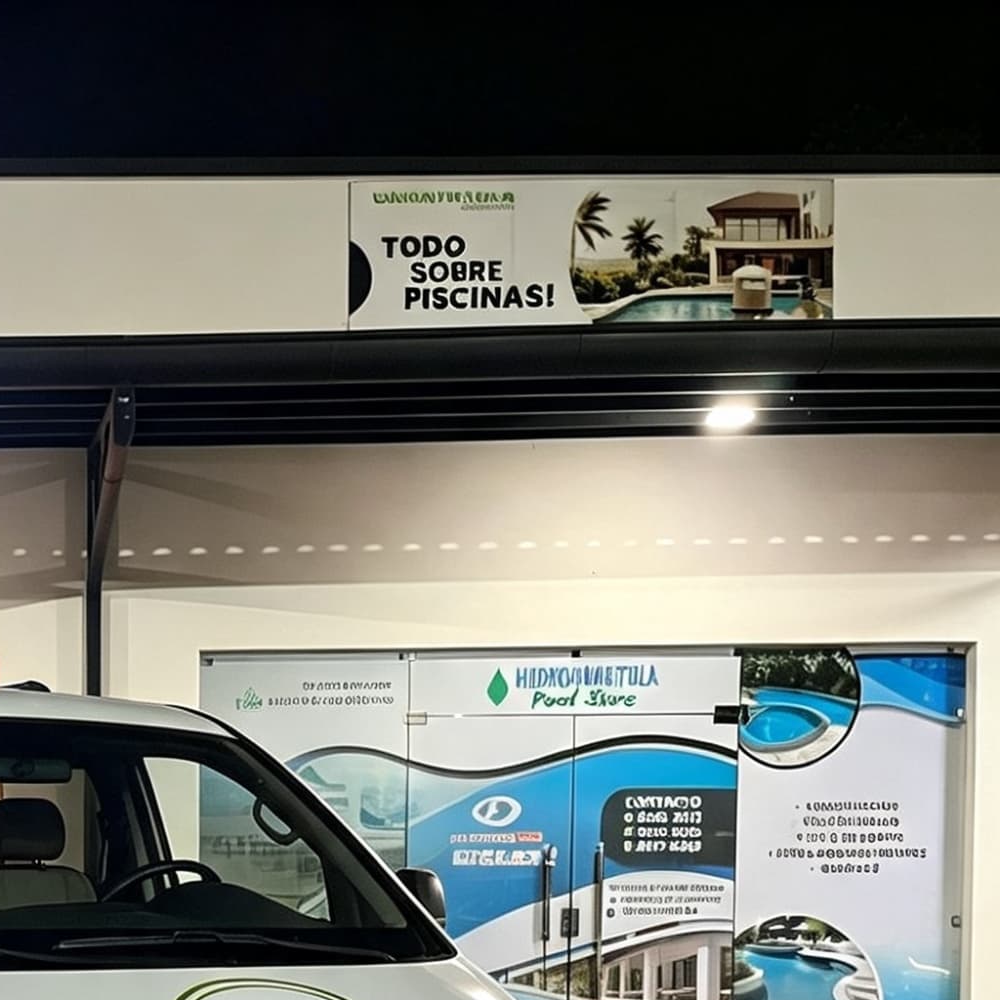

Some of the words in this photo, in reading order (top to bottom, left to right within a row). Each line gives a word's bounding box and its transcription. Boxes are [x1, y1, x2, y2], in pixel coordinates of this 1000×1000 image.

[380, 235, 466, 259] TODO
[410, 260, 504, 283] SOBRE
[404, 284, 555, 310] PISCINAS!
